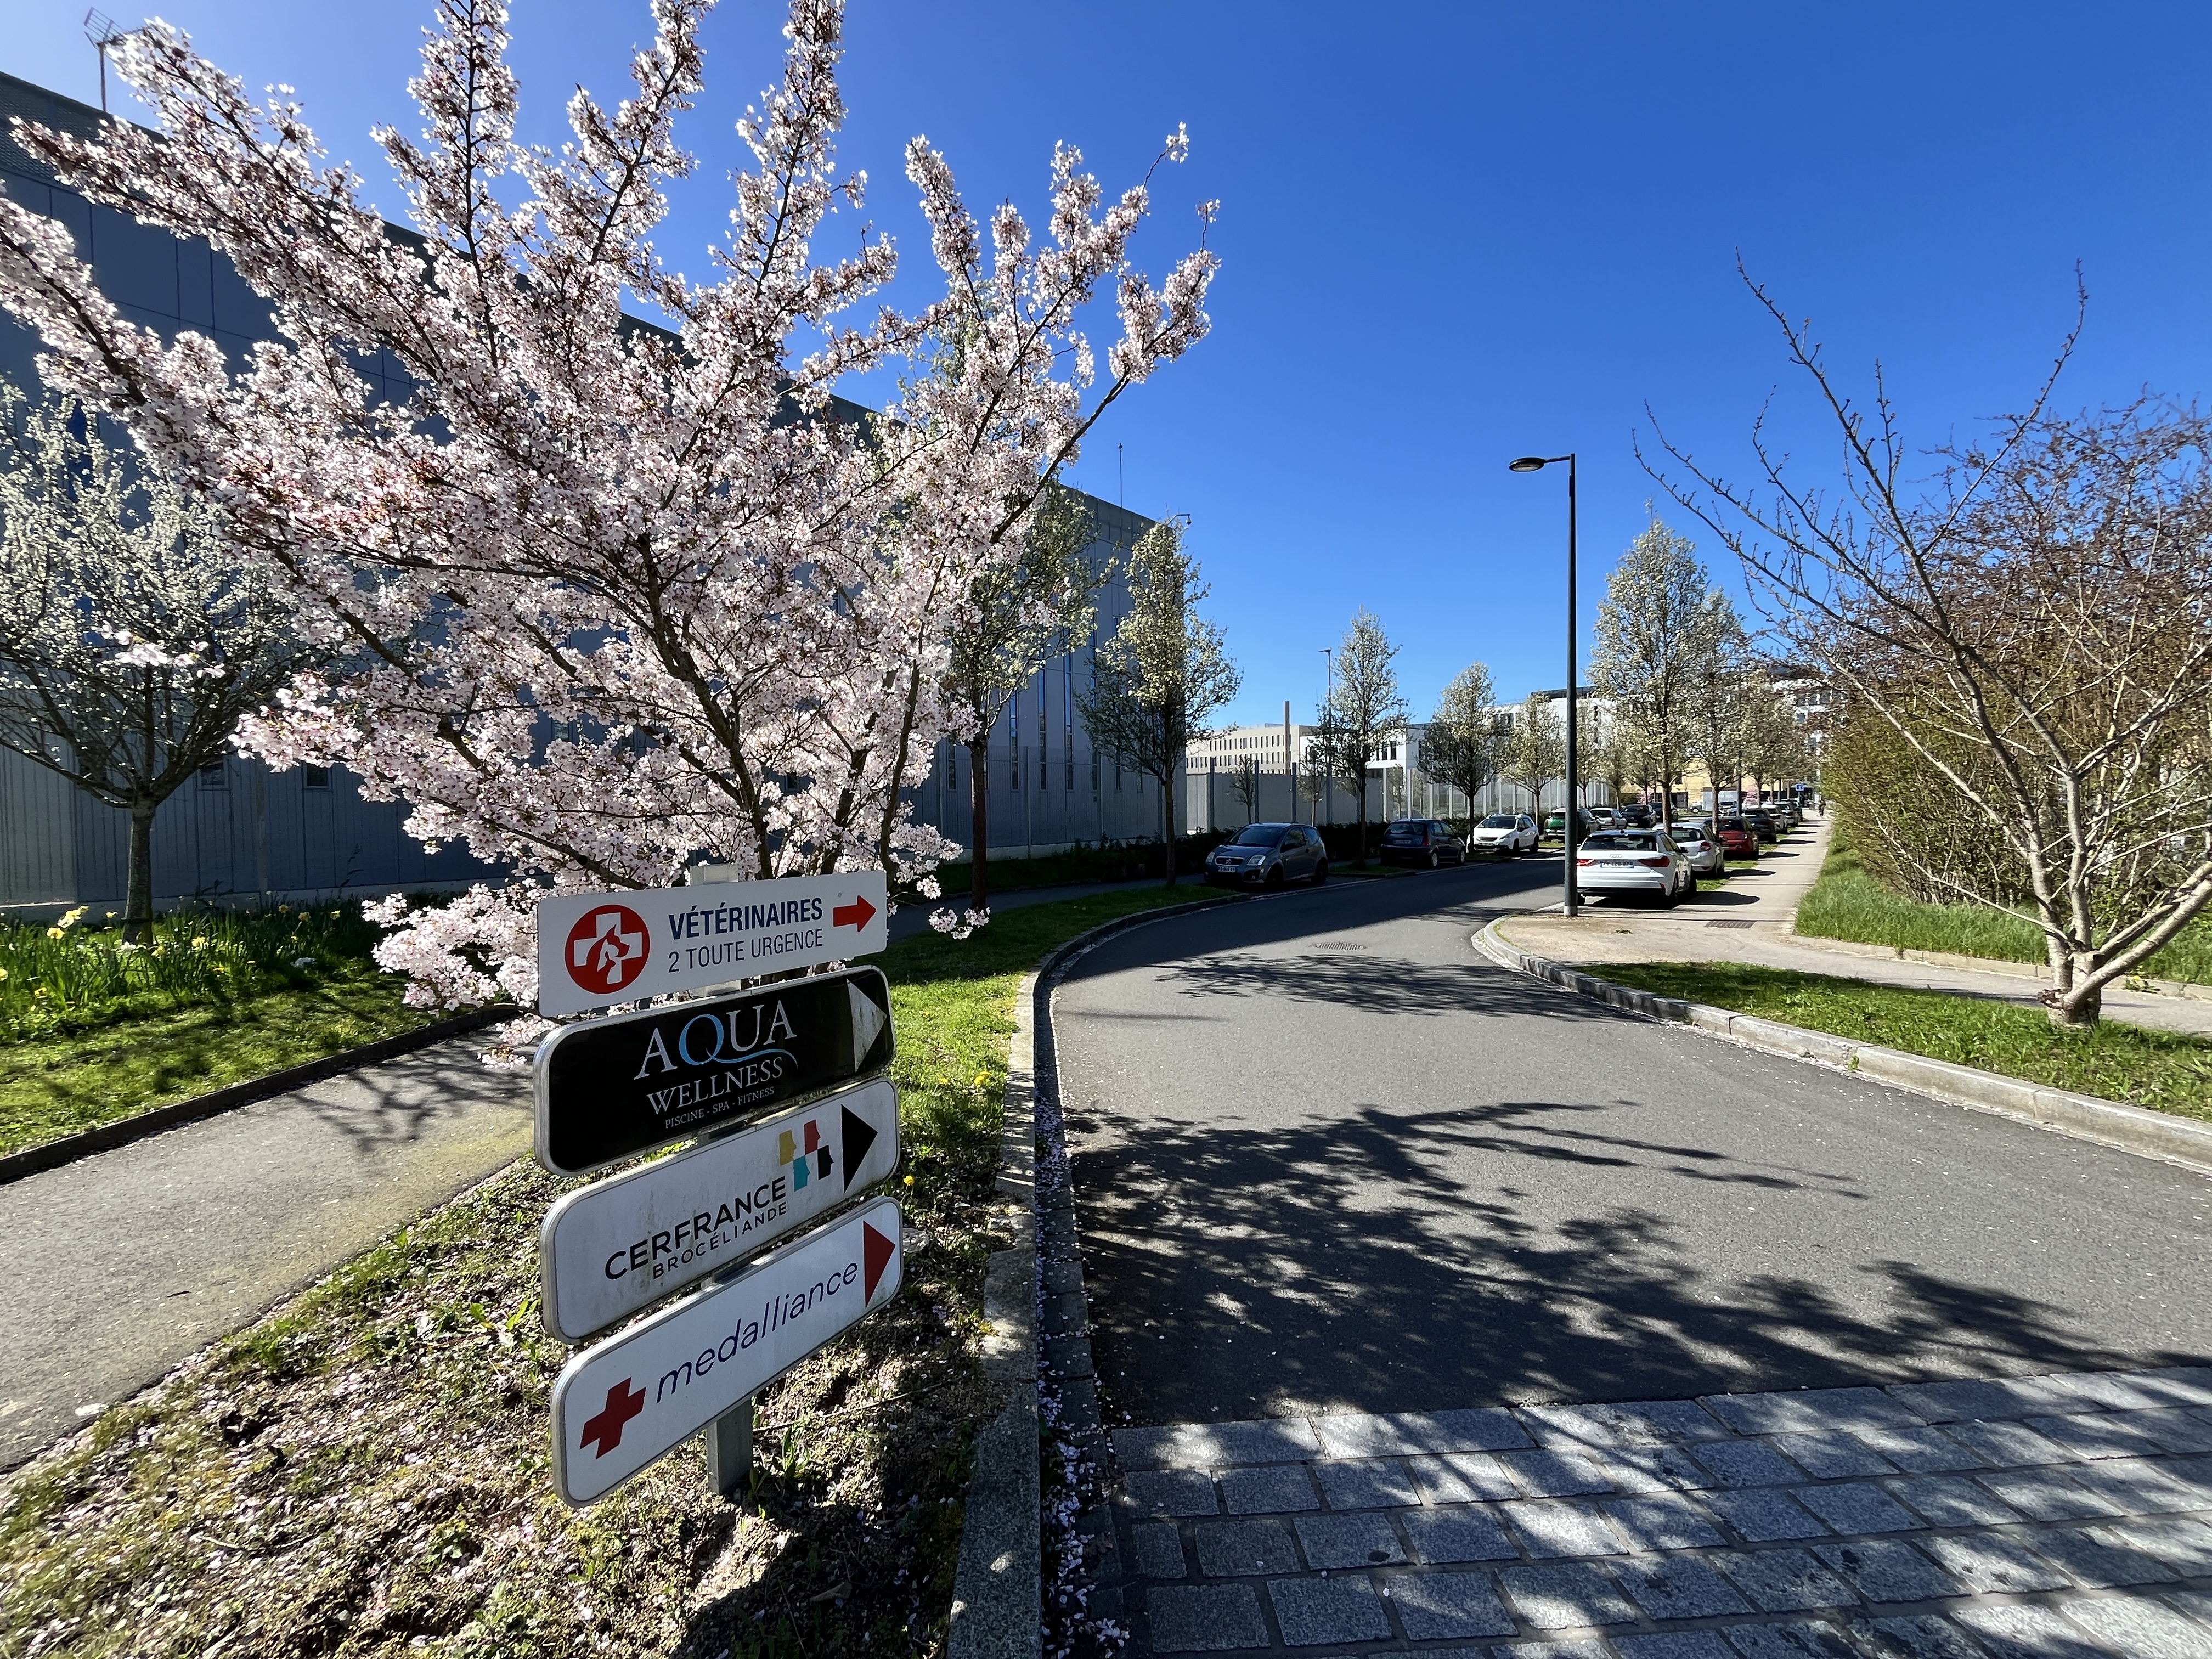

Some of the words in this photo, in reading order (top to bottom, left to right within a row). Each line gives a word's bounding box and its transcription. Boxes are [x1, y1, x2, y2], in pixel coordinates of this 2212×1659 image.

[668, 897, 823, 940] VÉTÉRINAIRES
[668, 951, 680, 973] 2
[685, 940, 744, 969] TOUTE
[751, 928, 823, 958] URGENCE
[633, 999, 798, 1080] AQUA
[646, 1057, 783, 1115] WELLNESS
[665, 1108, 704, 1129] PISCINE
[713, 1101, 730, 1114] SPA
[738, 1086, 775, 1105] FITNESS
[605, 1176, 786, 1280] CERFRANCE
[653, 1201, 787, 1280] BROCÉLIANDE
[656, 1262, 857, 1403] medalliance
